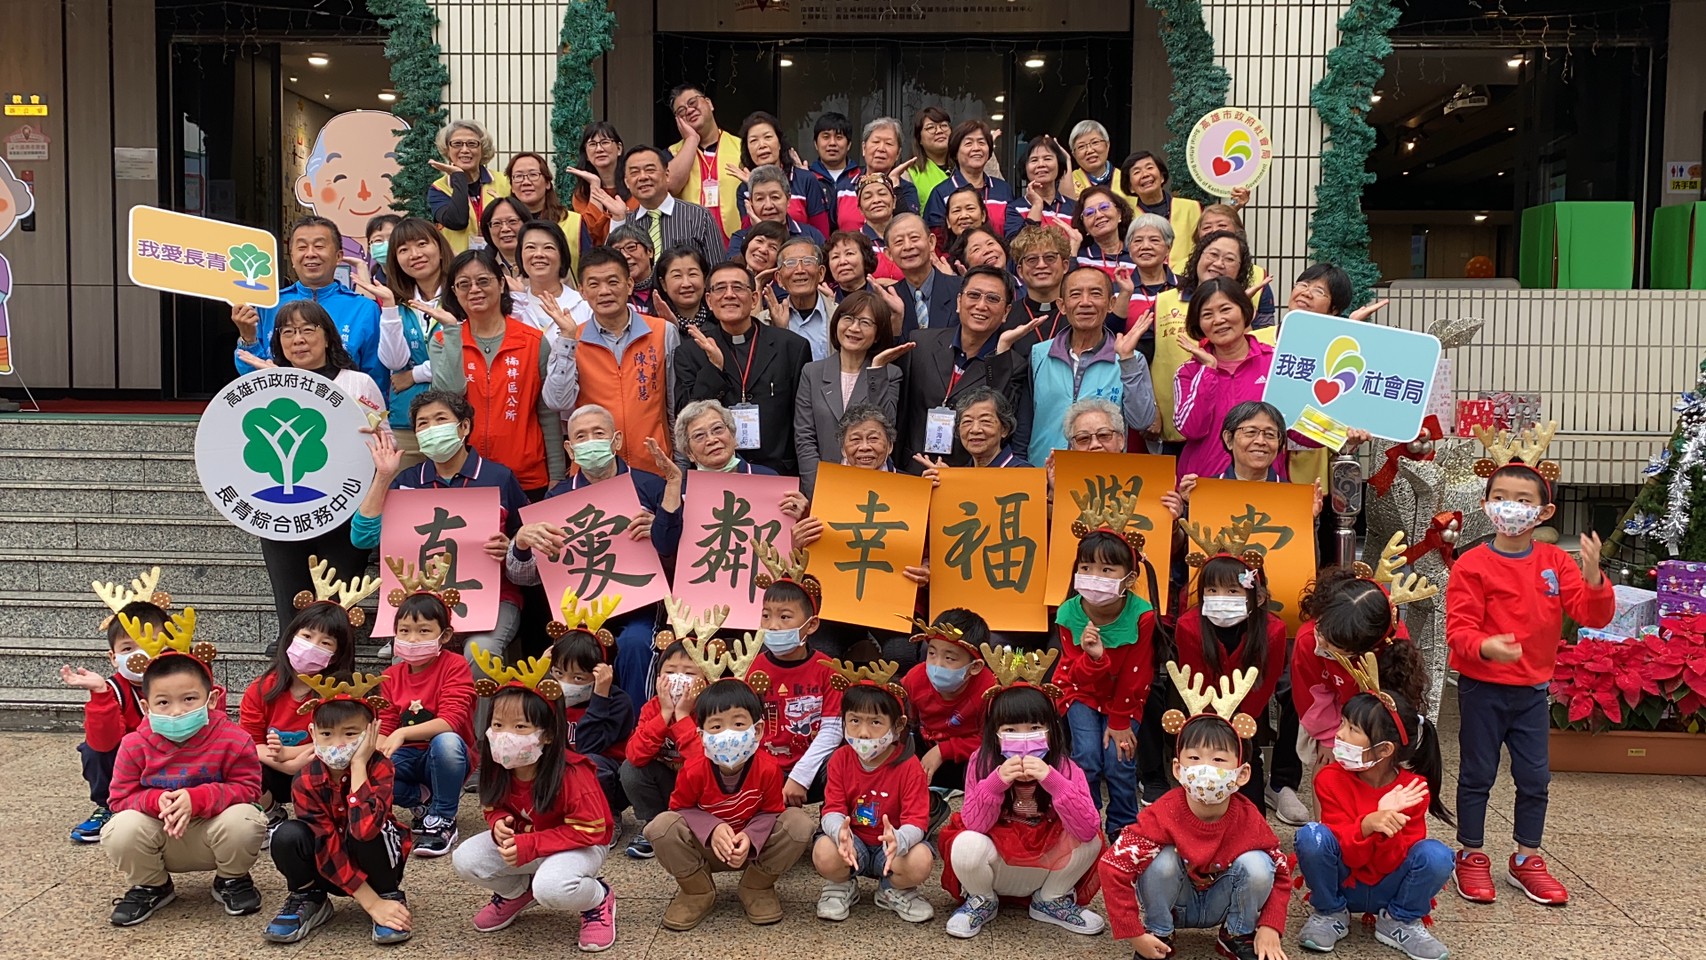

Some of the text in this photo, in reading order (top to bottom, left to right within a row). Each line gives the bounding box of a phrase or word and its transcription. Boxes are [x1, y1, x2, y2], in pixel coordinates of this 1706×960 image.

[1199, 110, 1271, 160] 高雄市政府社會局
[137, 239, 228, 272] 我愛長青
[222, 373, 345, 408] 高雄市政府社會局
[505, 356, 520, 422] 楠梓區公所
[633, 351, 651, 401] 陳善慧
[1275, 353, 1425, 404] 我愛 社會局
[214, 477, 362, 535] 長青綜合服務中心
[412, 506, 484, 619] 真
[547, 502, 658, 602] 愛
[688, 489, 783, 604] 鄰
[827, 489, 910, 602] 幸
[941, 491, 1038, 595] 福
[1331, 920, 1347, 936] N
[1390, 926, 1411, 944] N
